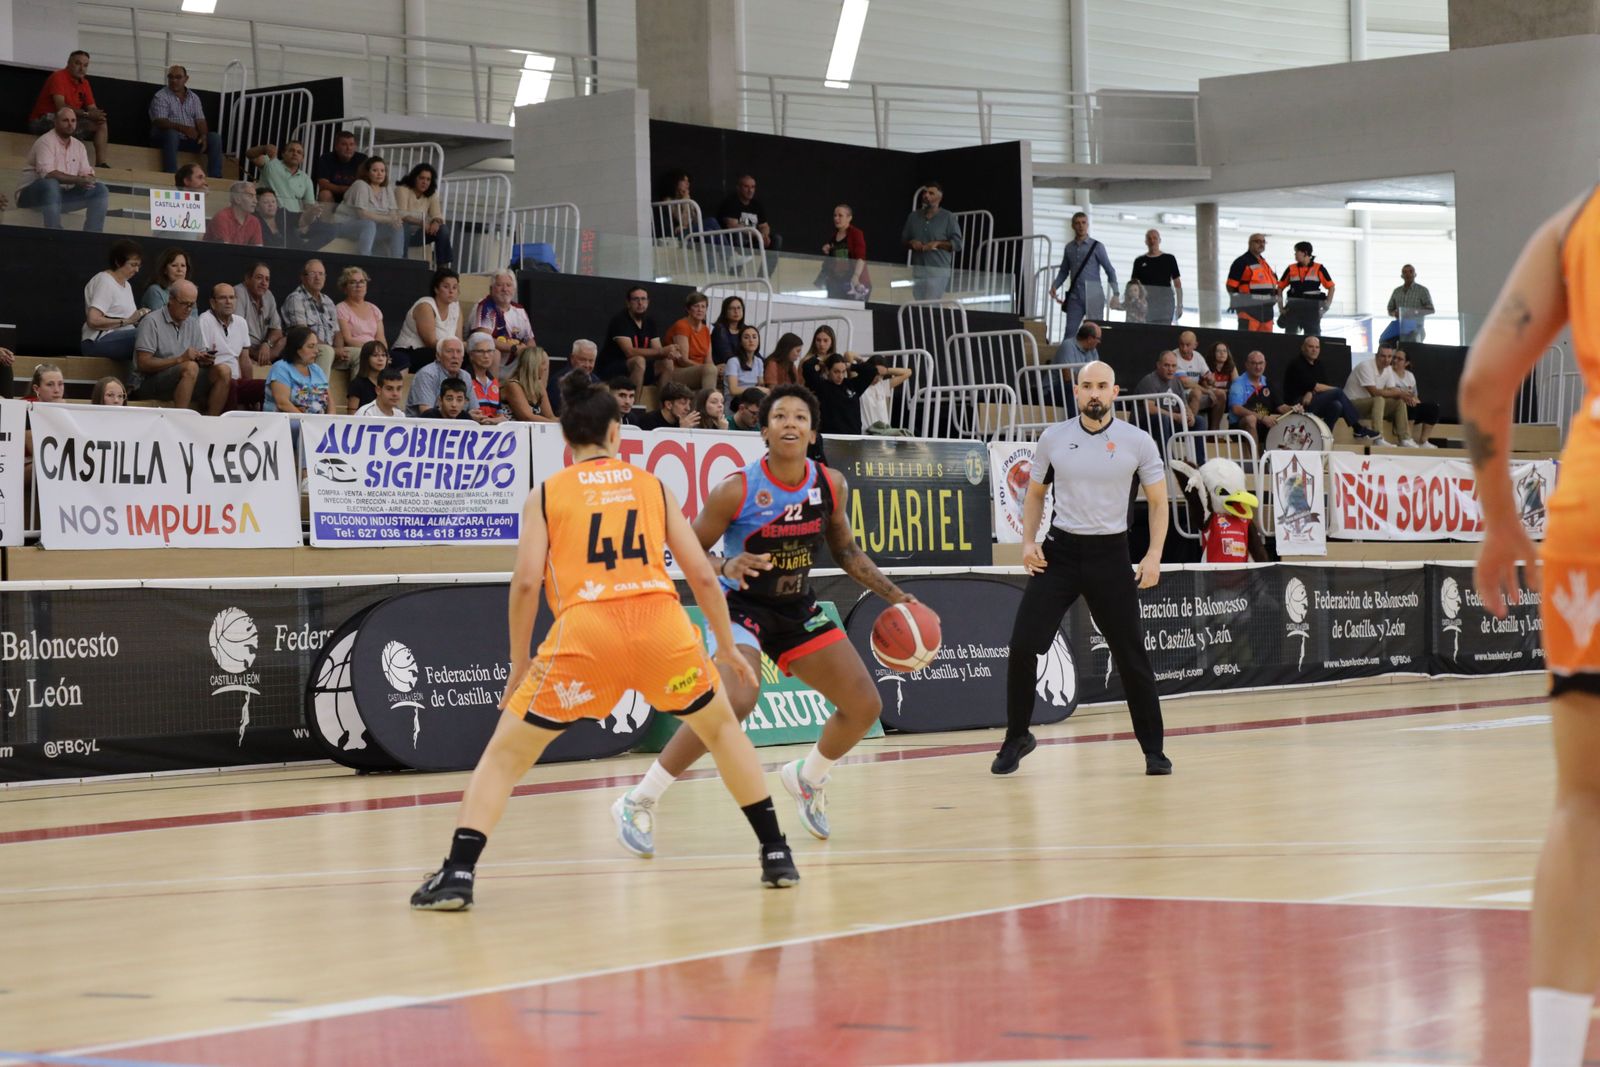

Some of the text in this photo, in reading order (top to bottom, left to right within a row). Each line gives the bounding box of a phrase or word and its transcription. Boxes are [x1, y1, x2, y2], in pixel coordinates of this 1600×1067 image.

[155, 211, 201, 229] es vida
[315, 422, 517, 461] AUTOBIERZO
[40, 426, 279, 494] CASTILLA Y LEÓN
[855, 461, 944, 478] EMBUTIDOS
[965, 458, 982, 472] 75
[364, 460, 515, 490] SIGFREDO
[578, 468, 633, 484] CASTRO
[58, 502, 261, 543] NOS IMPULSA
[320, 513, 514, 527] POLÍGONO INDUSTRIAL ALMÁZCARA (León)
[784, 504, 803, 521] 22
[850, 488, 972, 553] AJARIEL
[335, 528, 502, 538] Tel: 627 036 184 618 193 574
[761, 518, 823, 538] BEMBIBRE
[587, 509, 649, 571] 44
[770, 552, 813, 571] AJARIEL
[1180, 597, 1193, 617] de
[1194, 596, 1248, 617] Baloncesto
[1314, 590, 1419, 609] Federación de Baloncesto
[1332, 620, 1343, 639] de
[1344, 620, 1378, 639] Castilla
[1376, 623, 1384, 642] y
[1384, 618, 1406, 637] León
[1480, 616, 1491, 634] de
[1492, 615, 1519, 634] Castilla
[1519, 619, 1525, 637] y
[1, 630, 119, 661] Baloncesto
[1144, 624, 1233, 650] de Castilla y León
[957, 644, 968, 660] de
[967, 644, 1010, 659] Baloncest
[210, 674, 238, 686] CASTILLA
[244, 672, 260, 684] LEÓN
[425, 663, 507, 684] Federación de
[923, 664, 959, 679] Castilla
[959, 667, 966, 682] y
[966, 663, 992, 677] León
[6, 677, 83, 717] y León
[430, 689, 445, 707] de
[447, 687, 493, 706] Castilla
[44, 739, 100, 758] @FBCyL
